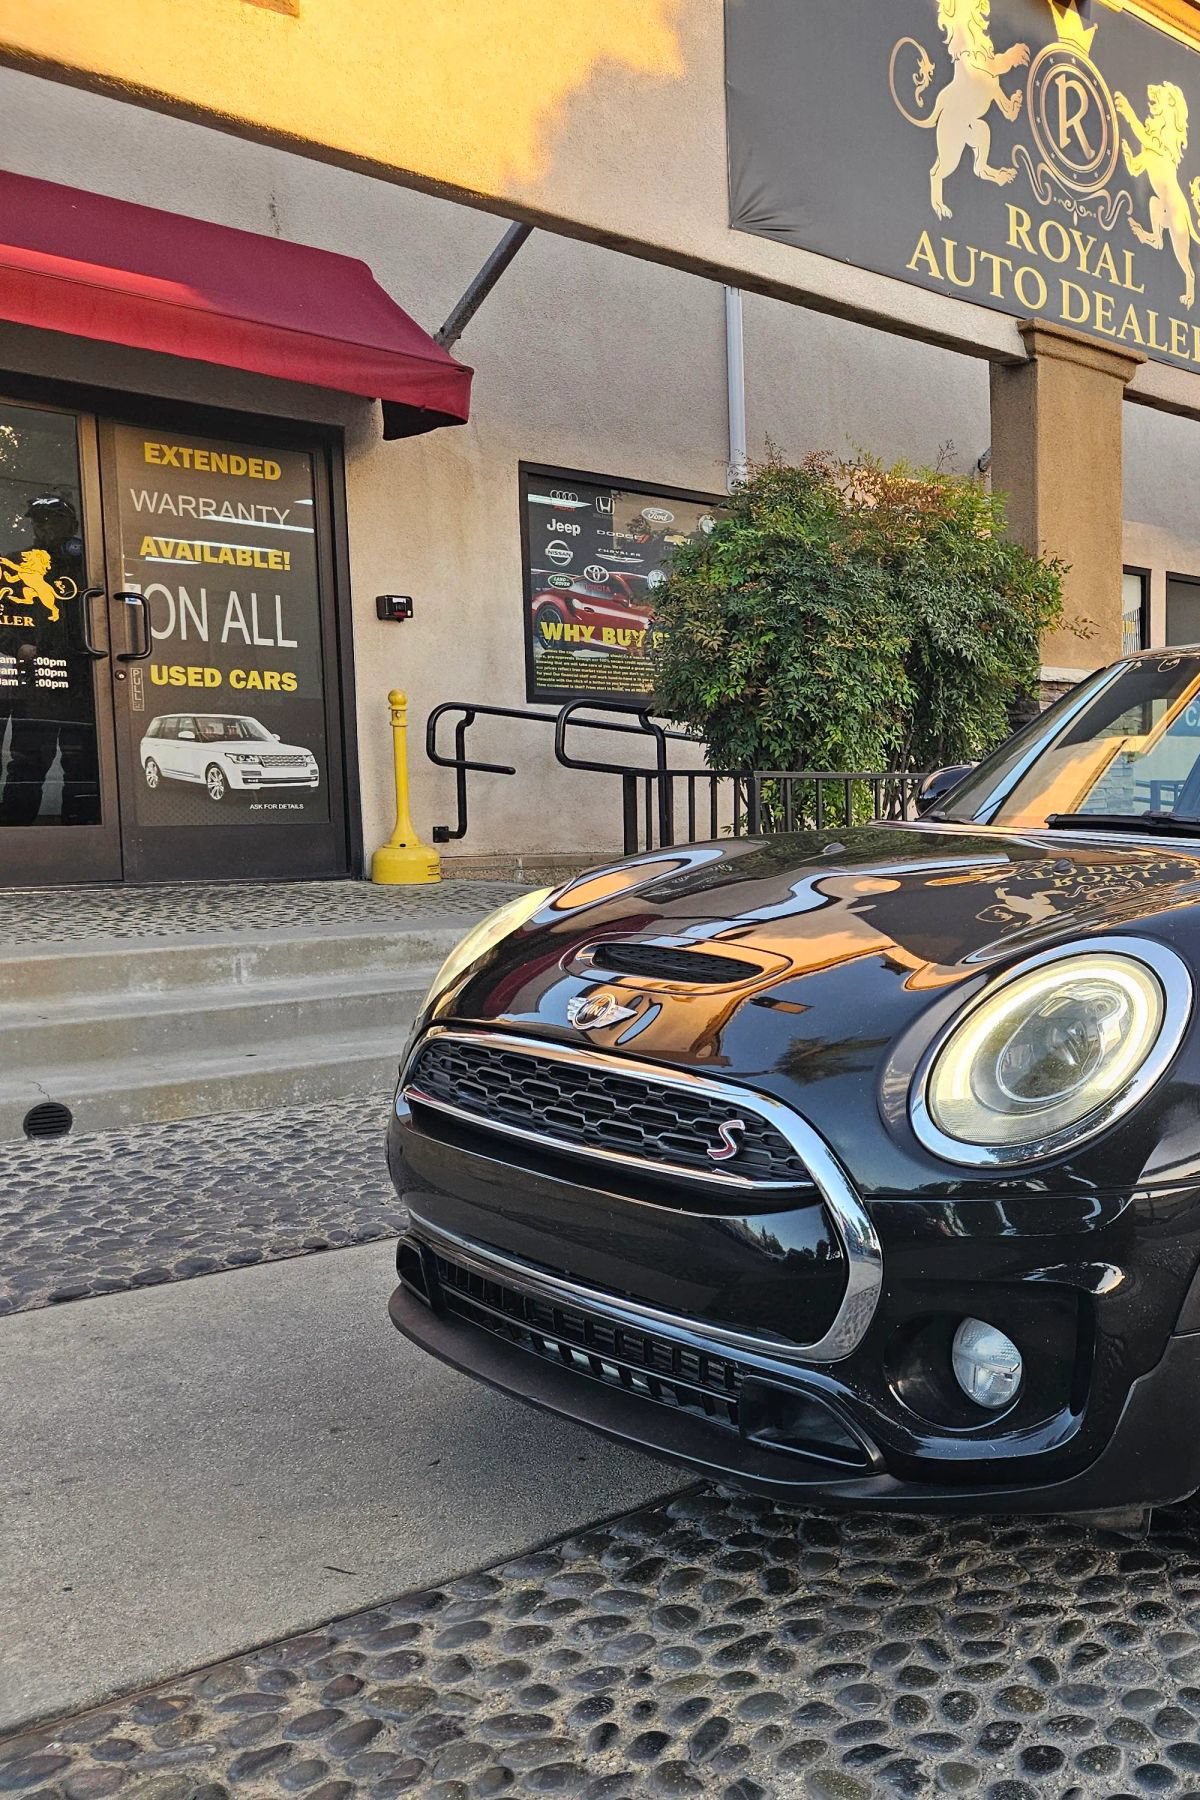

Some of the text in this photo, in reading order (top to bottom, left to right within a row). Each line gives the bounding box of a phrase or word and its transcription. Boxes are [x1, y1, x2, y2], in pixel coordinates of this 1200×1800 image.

[1054, 73, 1096, 160] R
[1005, 203, 1146, 294] ROYAL
[906, 230, 1048, 311] AUTO
[143, 441, 282, 481] EXTENDED
[129, 488, 291, 526] WARRANTY
[546, 518, 581, 537] Jeep
[596, 529, 641, 540] DODGE
[139, 535, 291, 571] AVAILABLE!
[548, 549, 571, 558] NISSAN
[0, 615, 35, 627] LER
[144, 583, 298, 649] ON ALL
[540, 621, 596, 643] WHY
[602, 627, 647, 649] BUY
[133, 669, 142, 701] PULL
[150, 664, 298, 692] USED CARS
[707, 1119, 746, 1161] S
